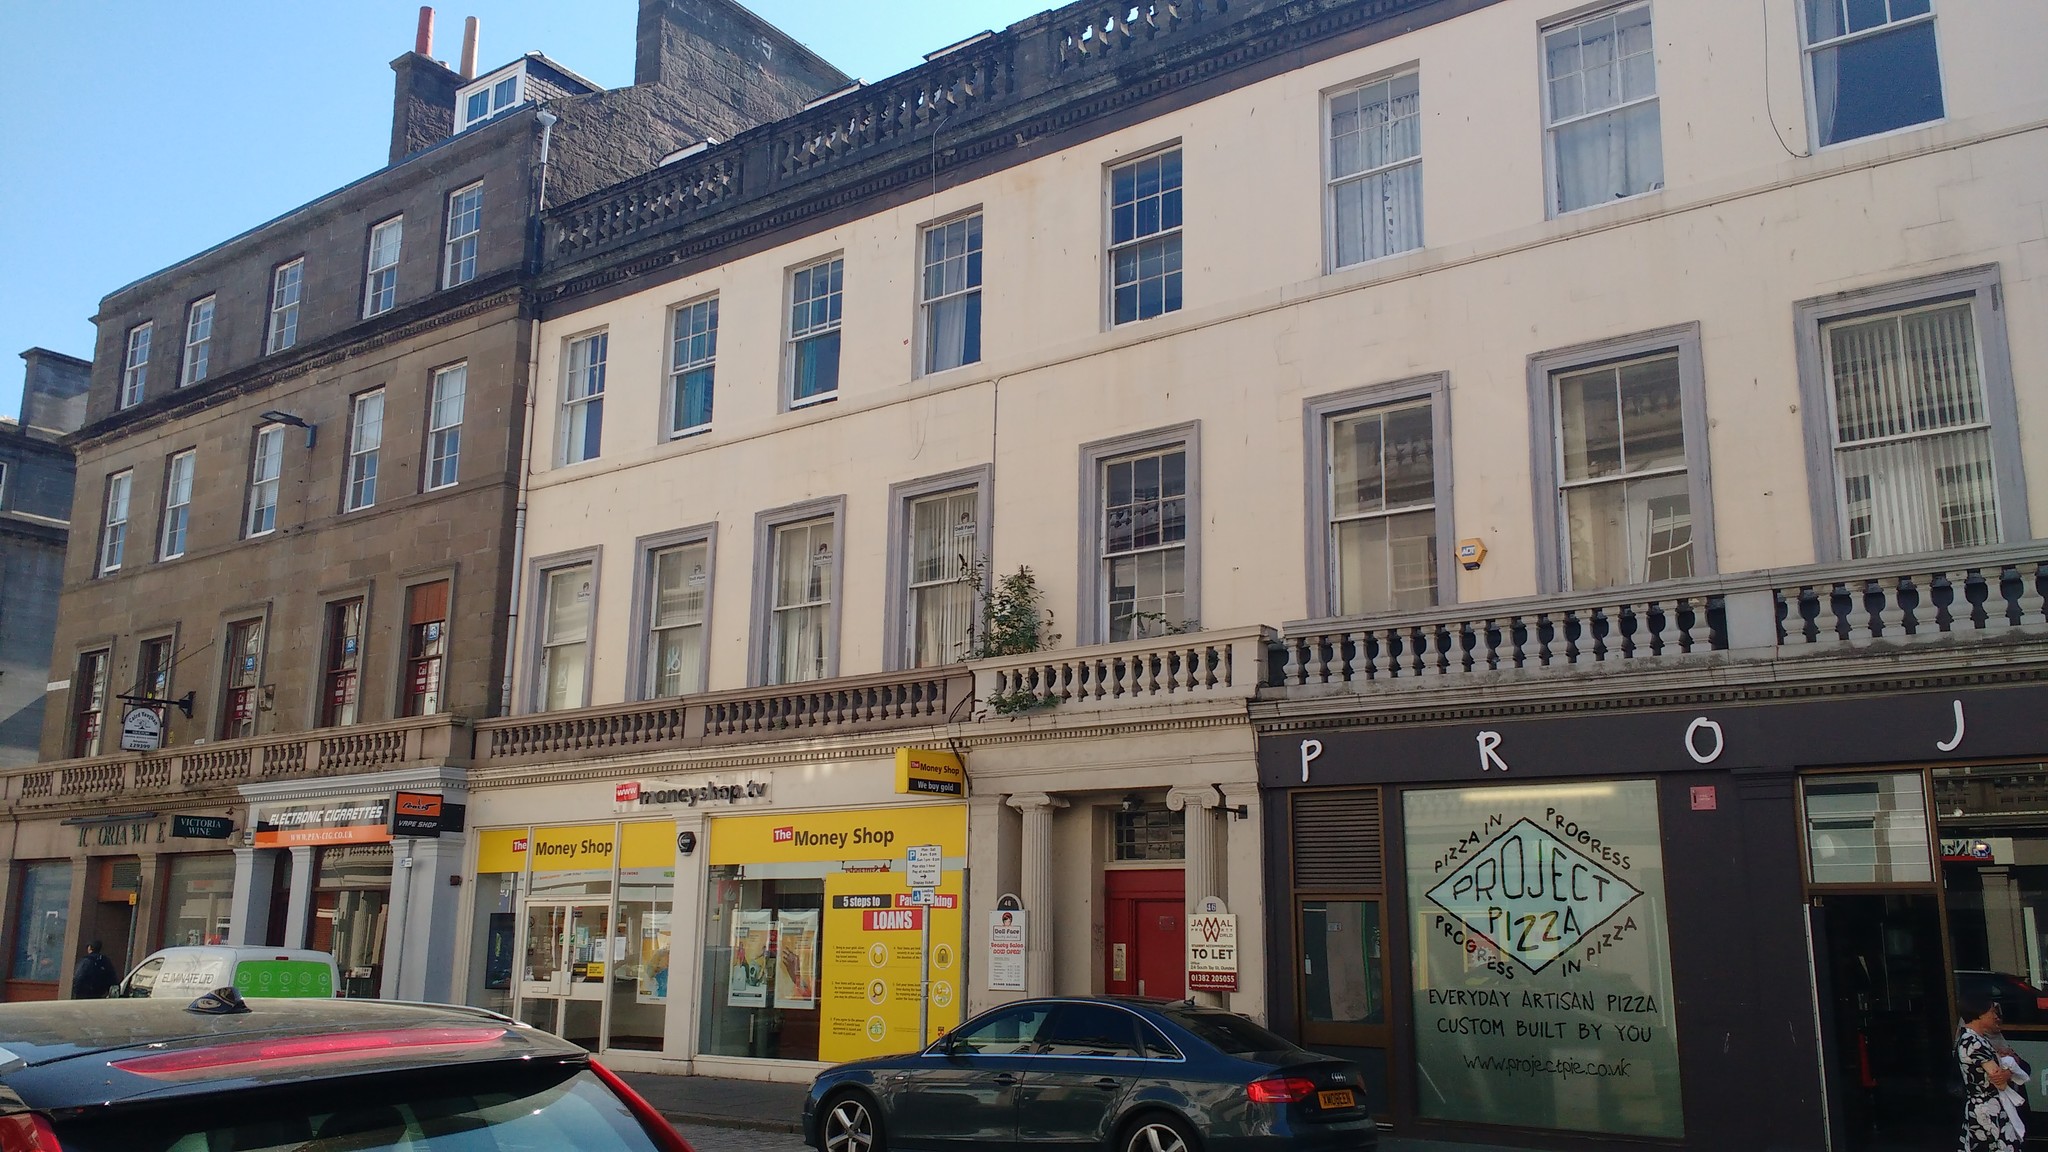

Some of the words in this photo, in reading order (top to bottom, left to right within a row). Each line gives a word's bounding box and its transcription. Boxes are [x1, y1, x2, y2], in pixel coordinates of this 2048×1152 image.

[1462, 547, 1475, 555] ADT
[920, 763, 942, 774] Money
[944, 765, 960, 776] Shop
[639, 779, 768, 807] moneyshop.tv
[917, 780, 928, 789] We
[928, 781, 940, 792] buy
[940, 783, 954, 793] gold
[180, 818, 222, 829] VICTORIA
[268, 809, 322, 827] ELECTRONIC
[324, 806, 384, 823] CIGARETTES
[188, 827, 212, 836] WINE
[774, 829, 792, 840] The
[794, 831, 848, 849] Money
[853, 827, 894, 847] Shop
[1435, 831, 1480, 874] PIZZA
[1484, 813, 1503, 836] IN
[1546, 807, 1631, 870] PROGRESS
[513, 841, 527, 852] The
[535, 842, 577, 858] Money
[581, 839, 613, 856] Shop
[1453, 835, 1611, 902] PROJECT
[843, 896, 848, 907] 5
[850, 896, 871, 908] steps
[872, 895, 880, 906] to
[873, 910, 912, 930] LOANS
[1487, 905, 1582, 951] PIZZA
[1192, 949, 1208, 959] TO
[1212, 949, 1233, 959] LET
[1436, 915, 1514, 980] PROGRESS
[1562, 959, 1582, 978] IN
[1586, 916, 1637, 962] PIZZA
[162, 972, 200, 984] ELIMINATE
[199, 973, 214, 985] LTD
[1191, 974, 1210, 982] 01382
[1211, 975, 1235, 983] 205055
[1429, 989, 1511, 1008] EVERYDAY
[1521, 990, 1595, 1012] ARTISAN
[1607, 994, 1658, 1014] PIZZA
[1437, 1017, 1505, 1037] CUSTOM
[1516, 1020, 1567, 1040] BUILT
[1579, 1023, 1603, 1041] BY
[1614, 1024, 1652, 1043] YOU
